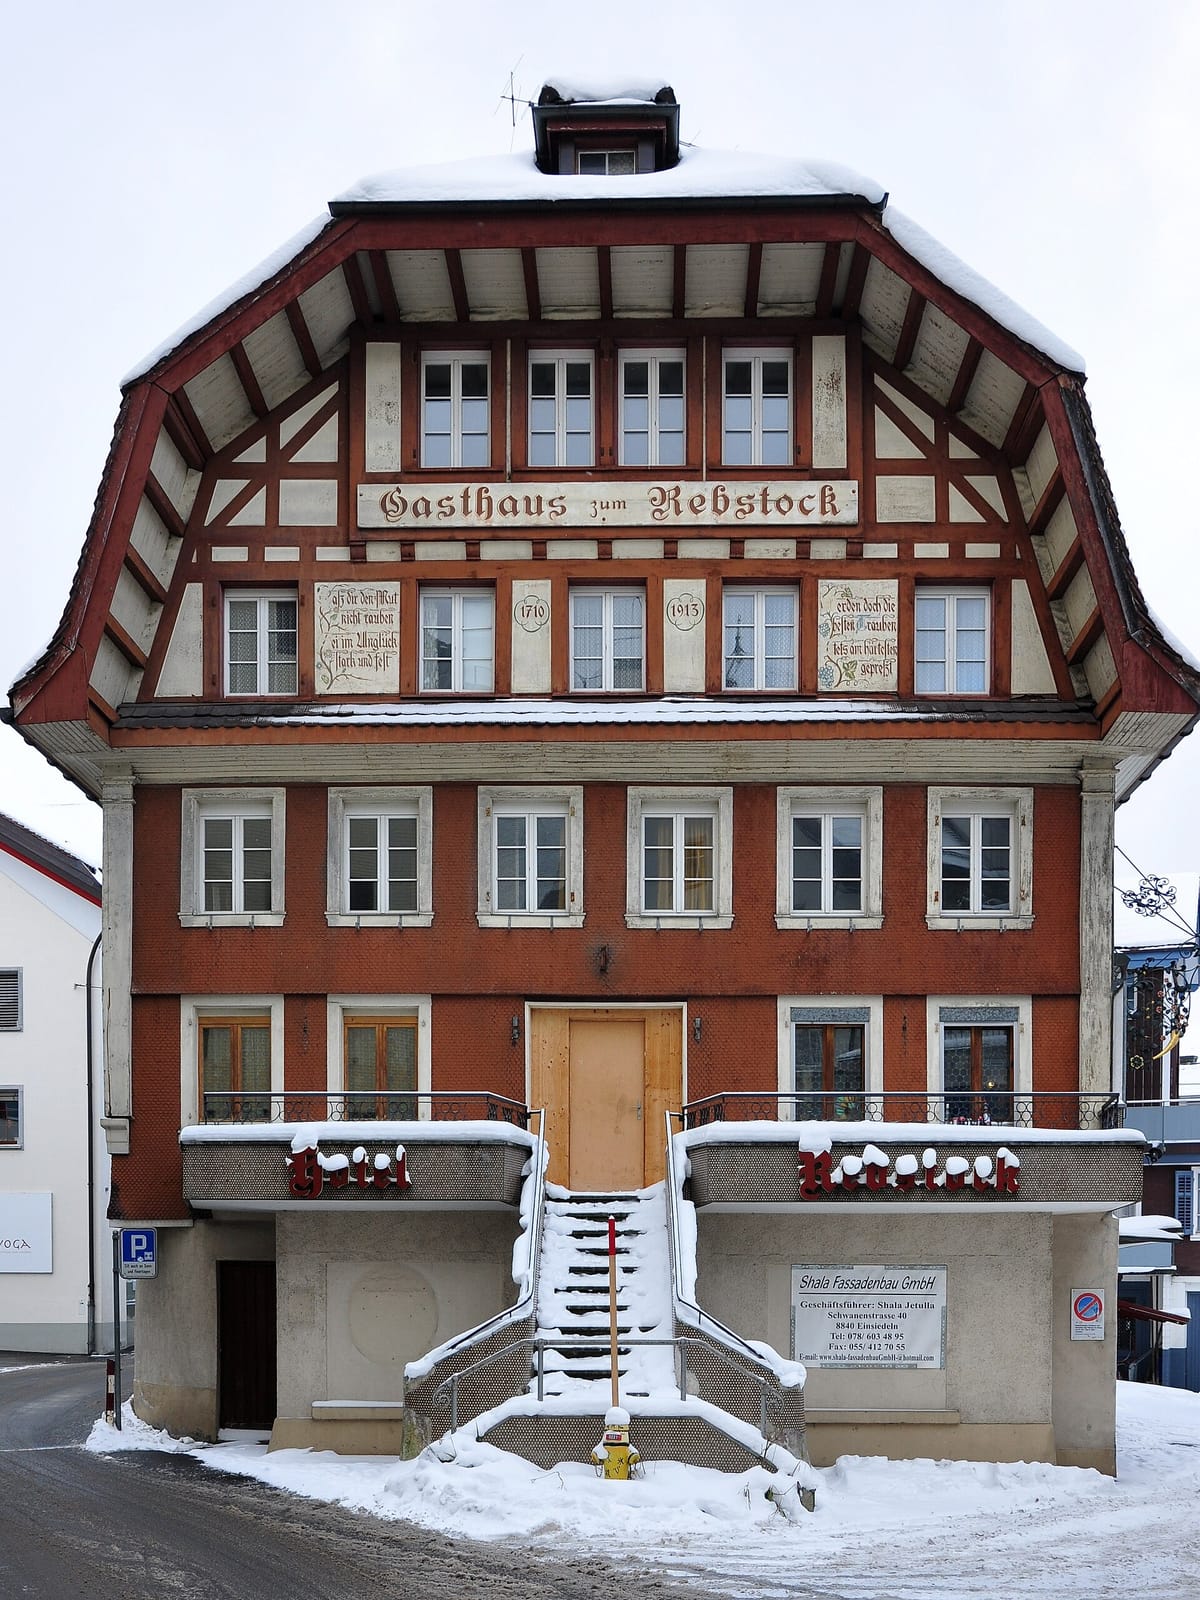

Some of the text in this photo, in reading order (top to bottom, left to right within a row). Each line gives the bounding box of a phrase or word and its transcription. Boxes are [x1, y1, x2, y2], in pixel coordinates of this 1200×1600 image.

[380, 484, 841, 523] Gasthaus zum Rebstock
[520, 604, 545, 619] 1710
[671, 602, 699, 618] 1913
[800, 1275, 936, 1290] Shala Fassadenbau GmbH
[800, 1301, 935, 1310] Geschäftsführer: Shala Jetulla
[835, 1322, 899, 1330] 8840 Einsiedeln
